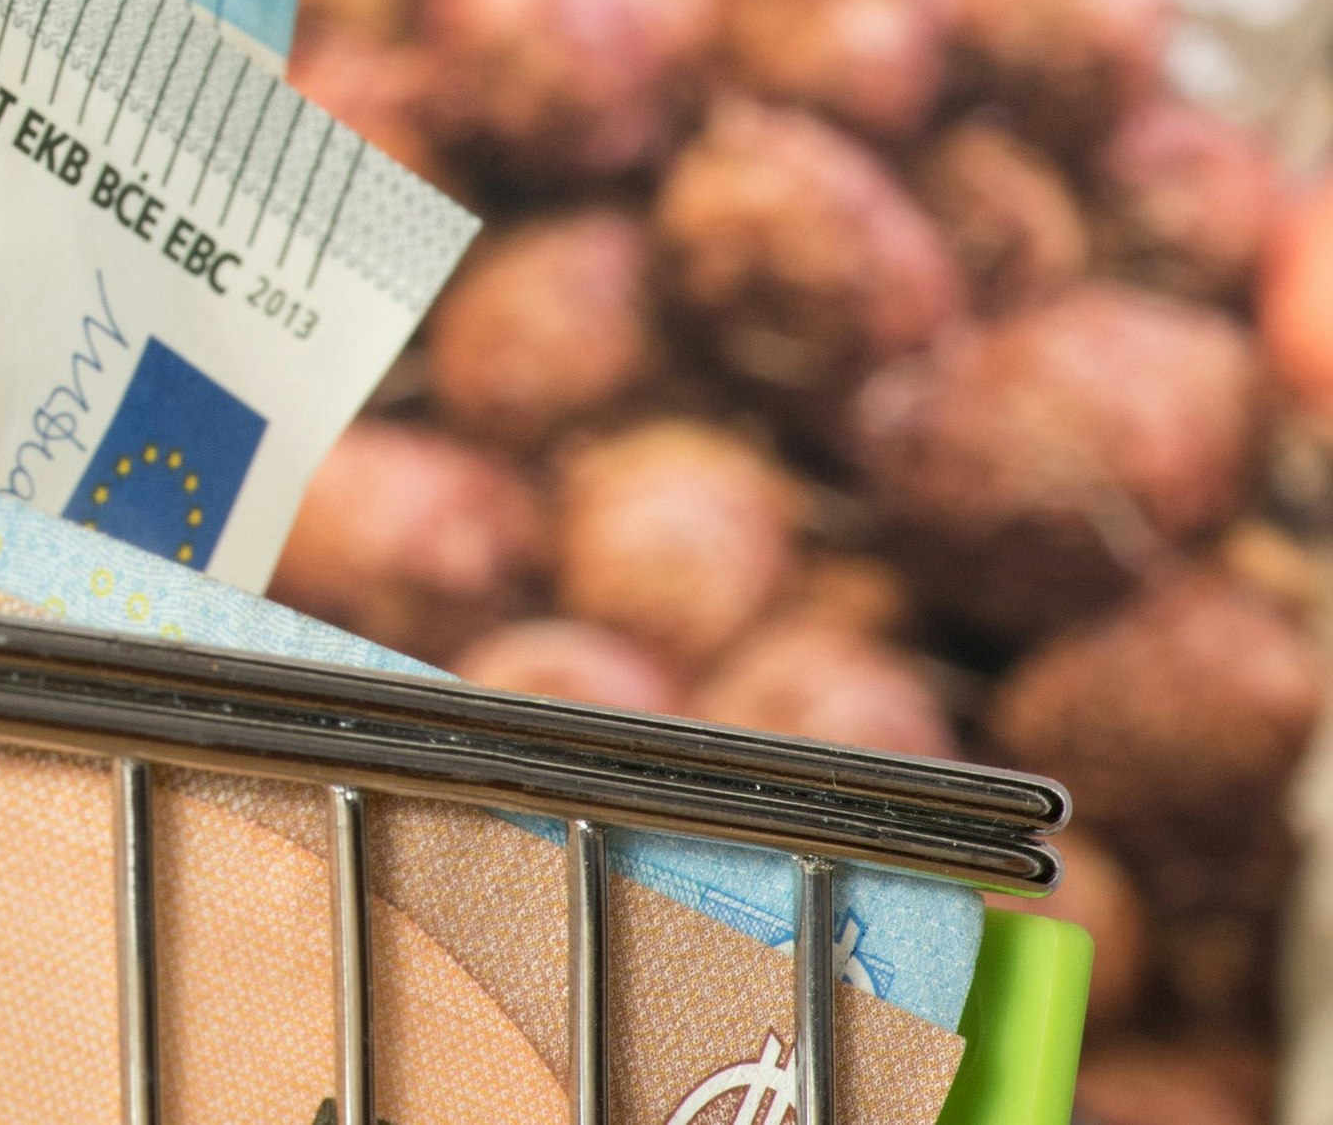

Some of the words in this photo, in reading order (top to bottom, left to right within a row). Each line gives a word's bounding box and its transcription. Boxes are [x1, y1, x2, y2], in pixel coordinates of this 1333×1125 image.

[13, 109, 90, 187] EKB
[163, 216, 244, 296] EBC
[246, 275, 320, 340] 2013
